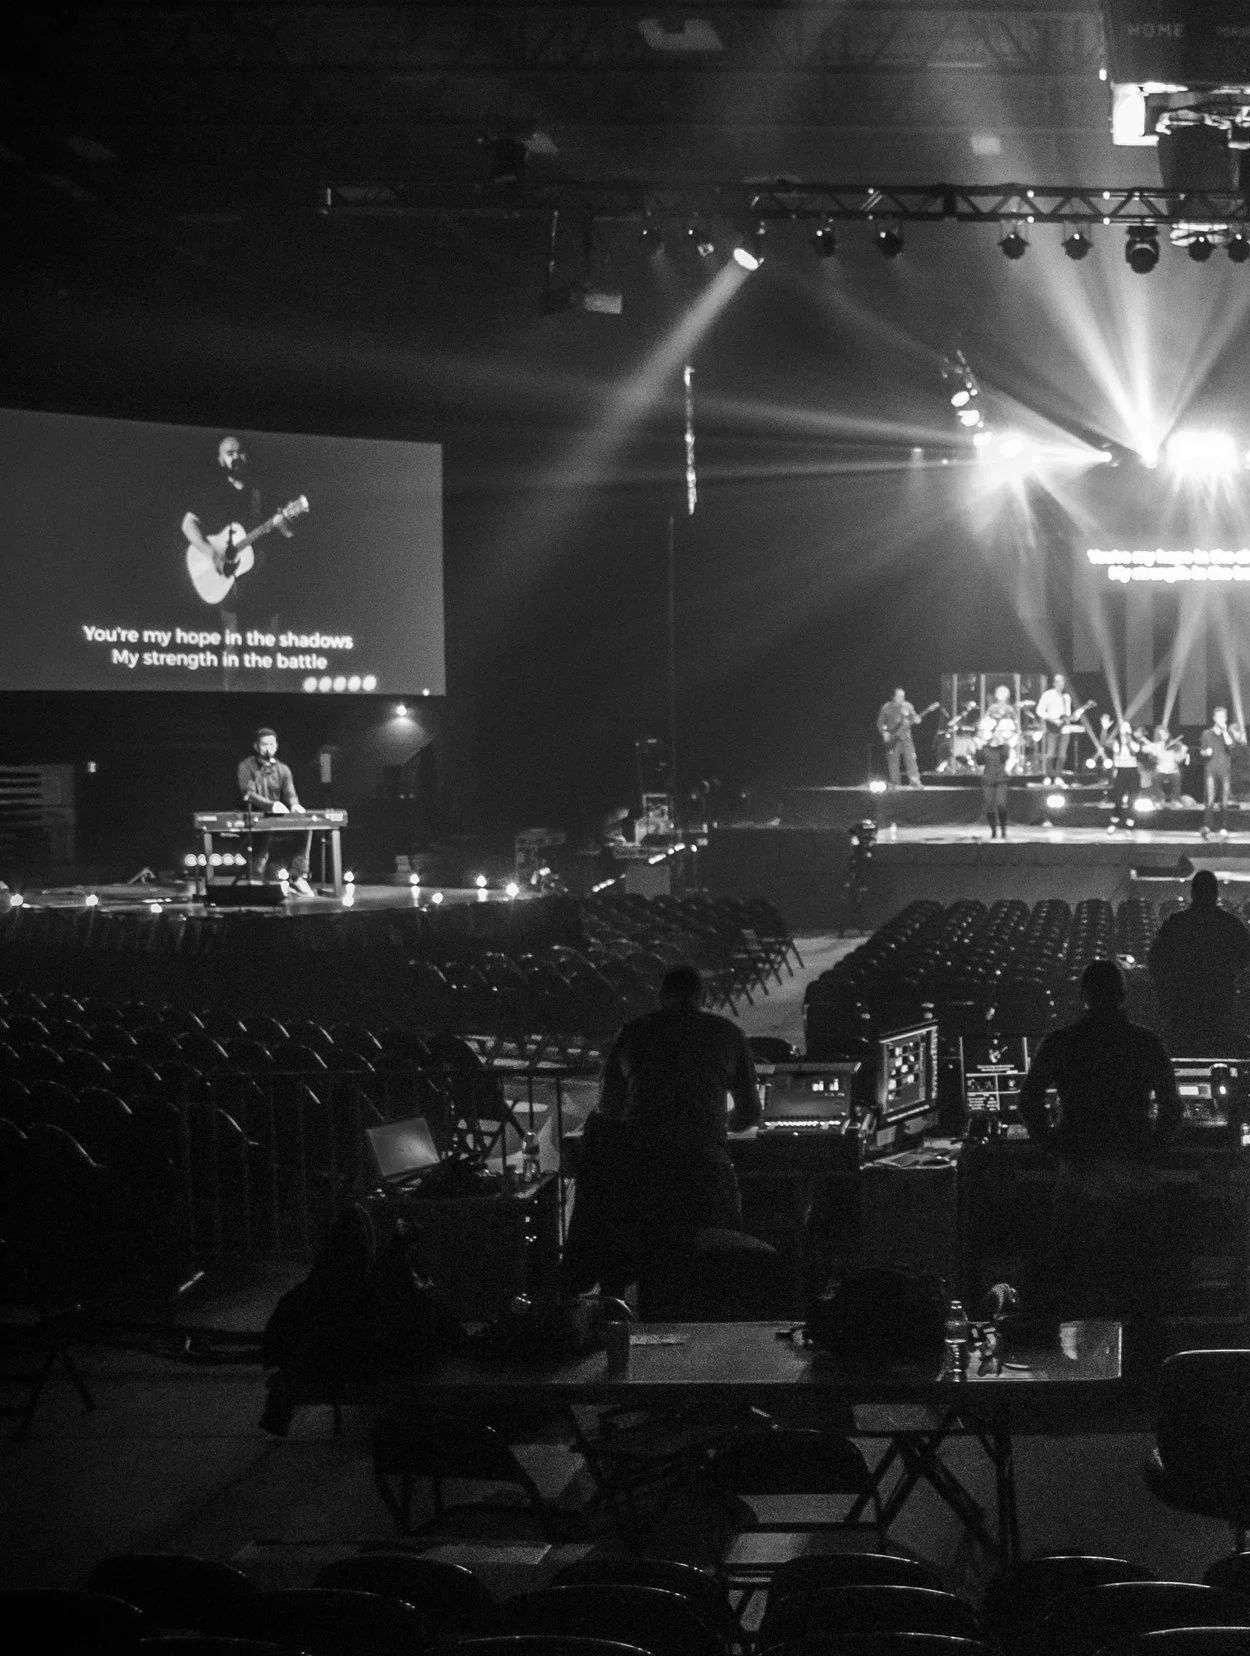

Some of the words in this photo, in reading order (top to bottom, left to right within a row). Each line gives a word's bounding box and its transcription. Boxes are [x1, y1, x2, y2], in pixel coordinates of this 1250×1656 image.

[1127, 23, 1184, 38] HOME
[83, 626, 139, 643] You're
[143, 630, 171, 647] my
[175, 628, 221, 647] hope
[225, 629, 242, 645] in
[246, 630, 276, 647] the
[279, 631, 354, 649] shadows
[112, 649, 139, 669] My
[143, 650, 218, 670] strength
[222, 651, 239, 667] in
[243, 652, 272, 669] the
[277, 653, 327, 670] battle
